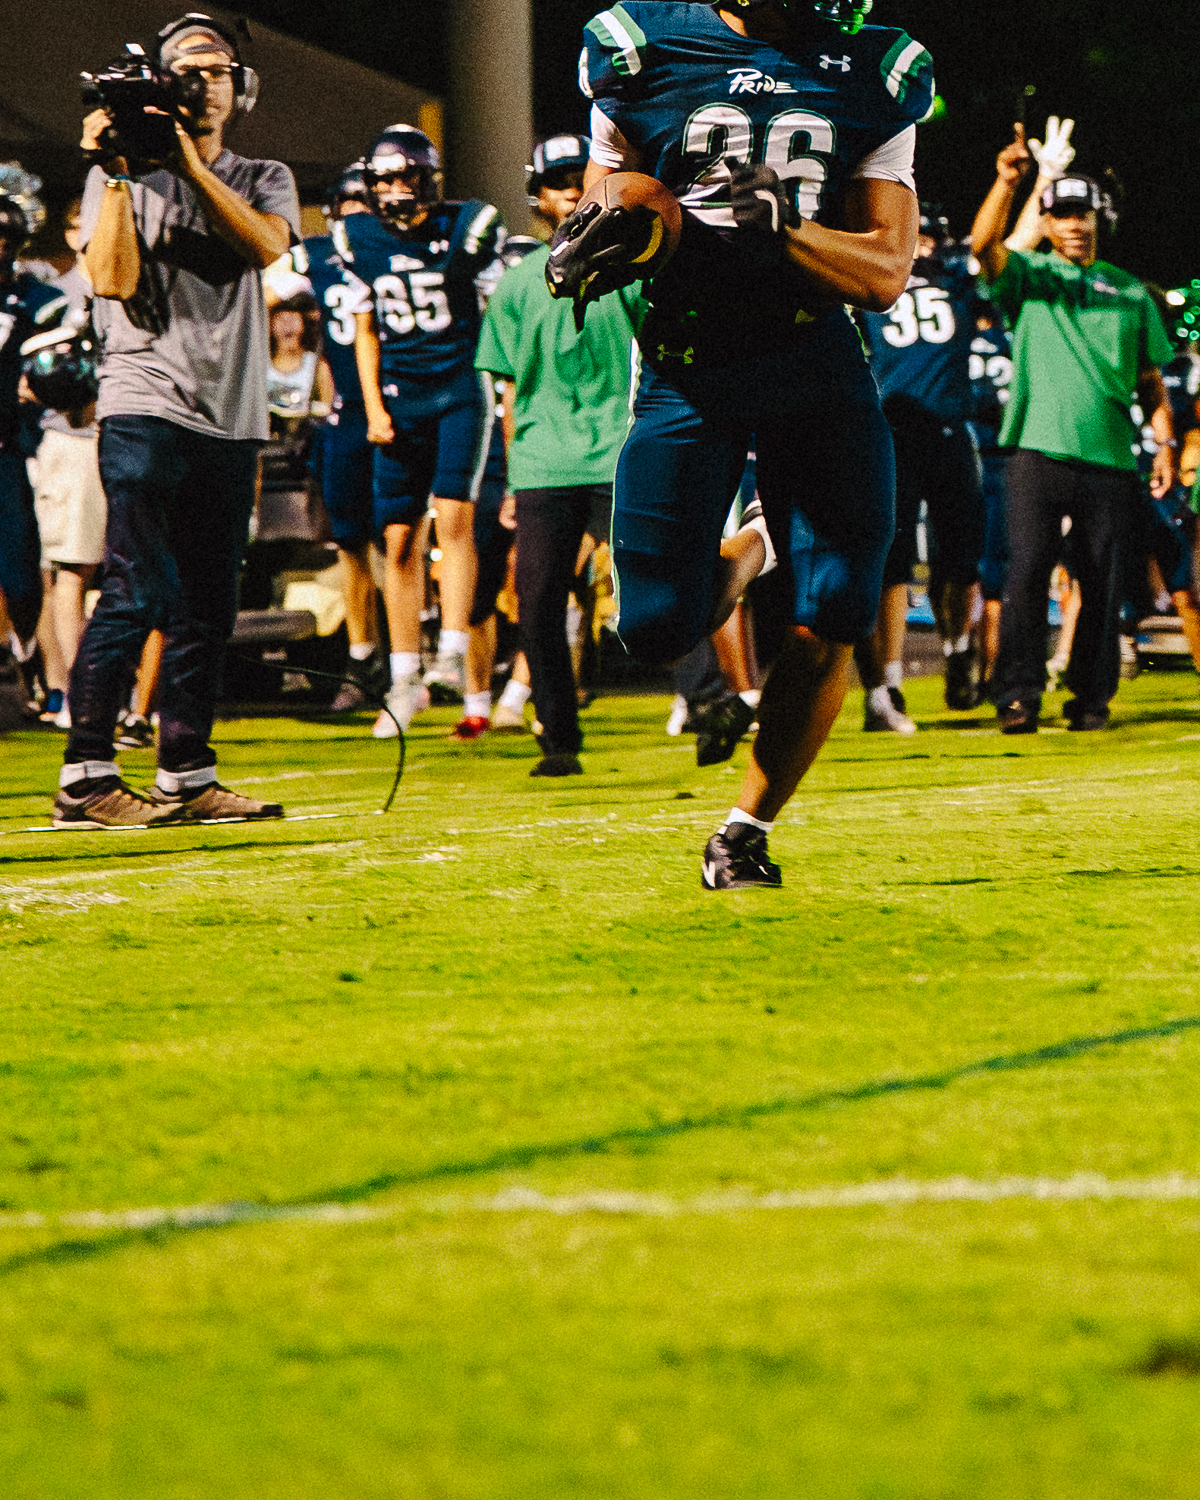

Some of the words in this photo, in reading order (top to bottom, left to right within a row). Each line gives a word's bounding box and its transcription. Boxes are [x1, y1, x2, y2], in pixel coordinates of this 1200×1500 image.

[727, 67, 799, 95] PRIDE
[682, 102, 838, 221] 26
[882, 287, 956, 348] 35
